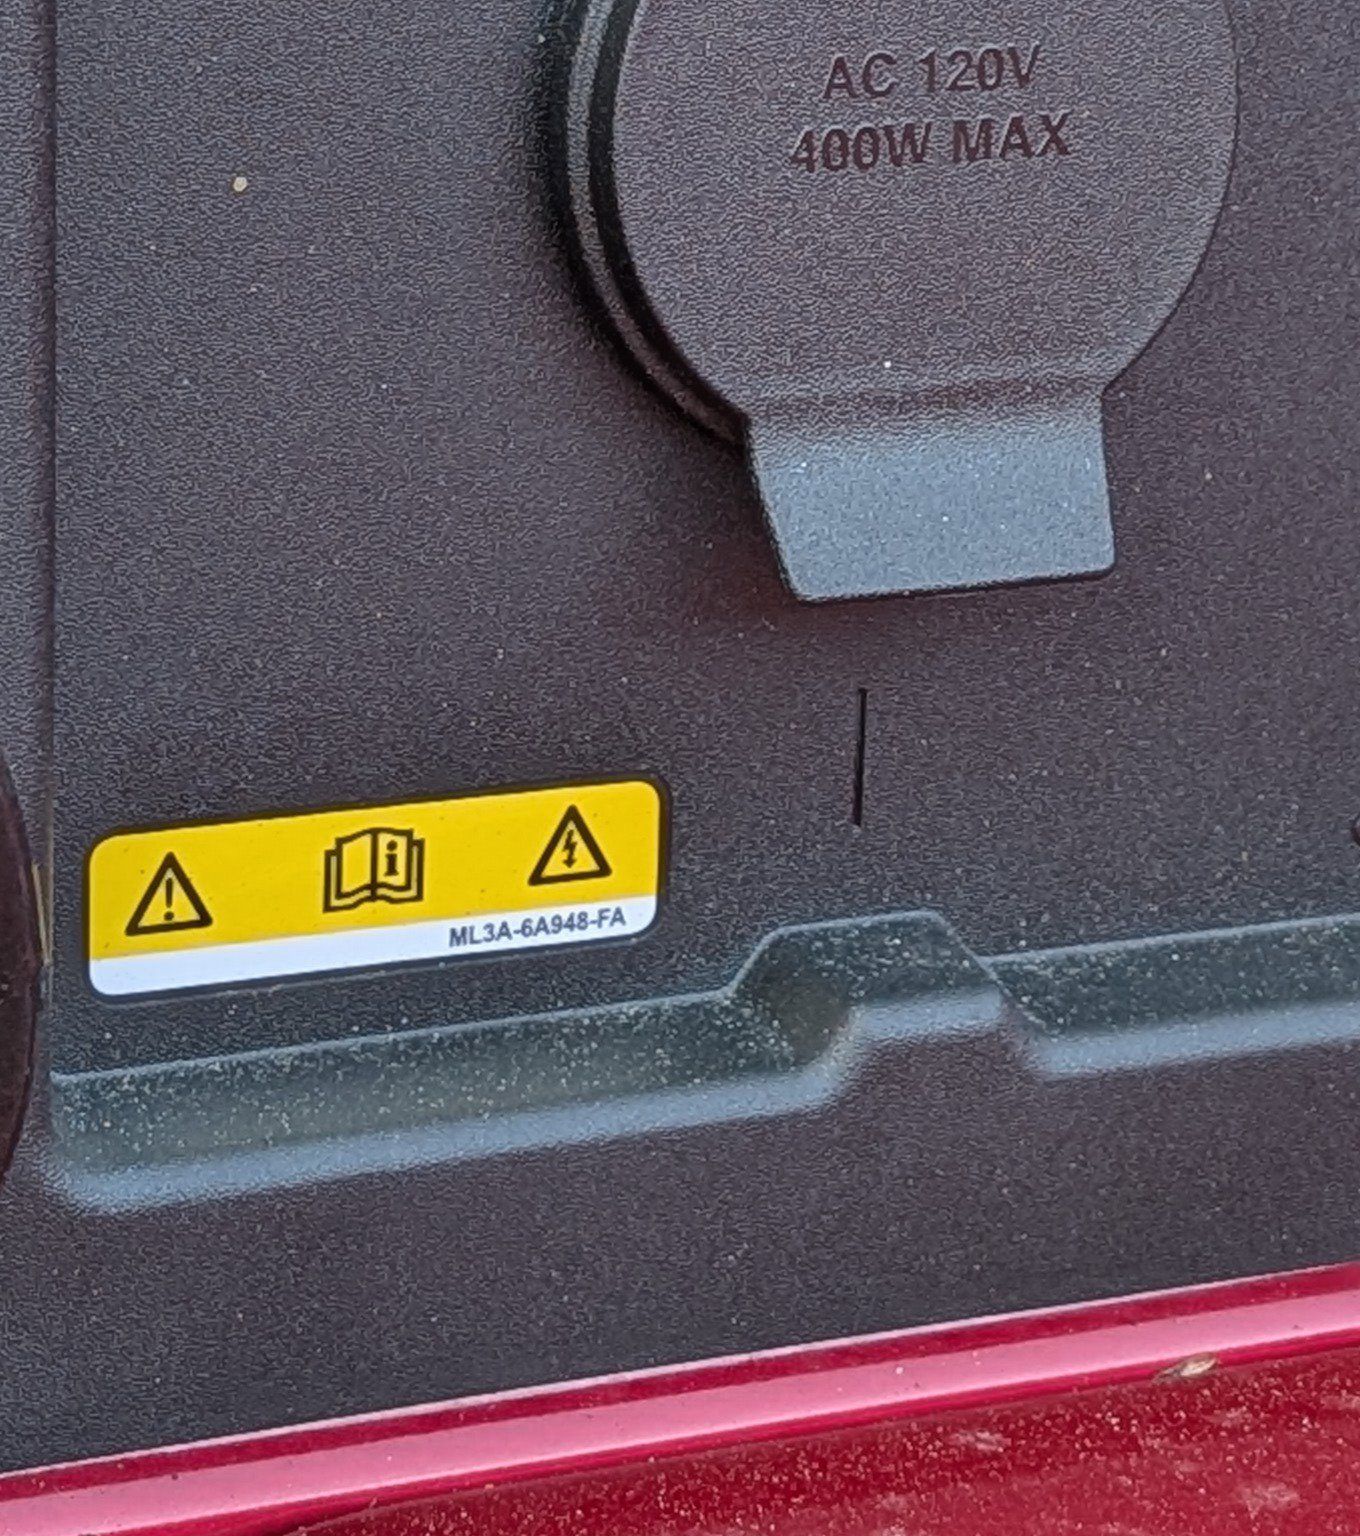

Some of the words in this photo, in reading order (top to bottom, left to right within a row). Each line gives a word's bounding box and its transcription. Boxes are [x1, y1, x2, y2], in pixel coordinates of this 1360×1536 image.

[821, 51, 897, 99] AC
[918, 43, 1040, 93] 120V
[790, 120, 932, 172] 400W
[951, 112, 1072, 164] MAX
[448, 906, 627, 948] ML3A-6A948-FA
